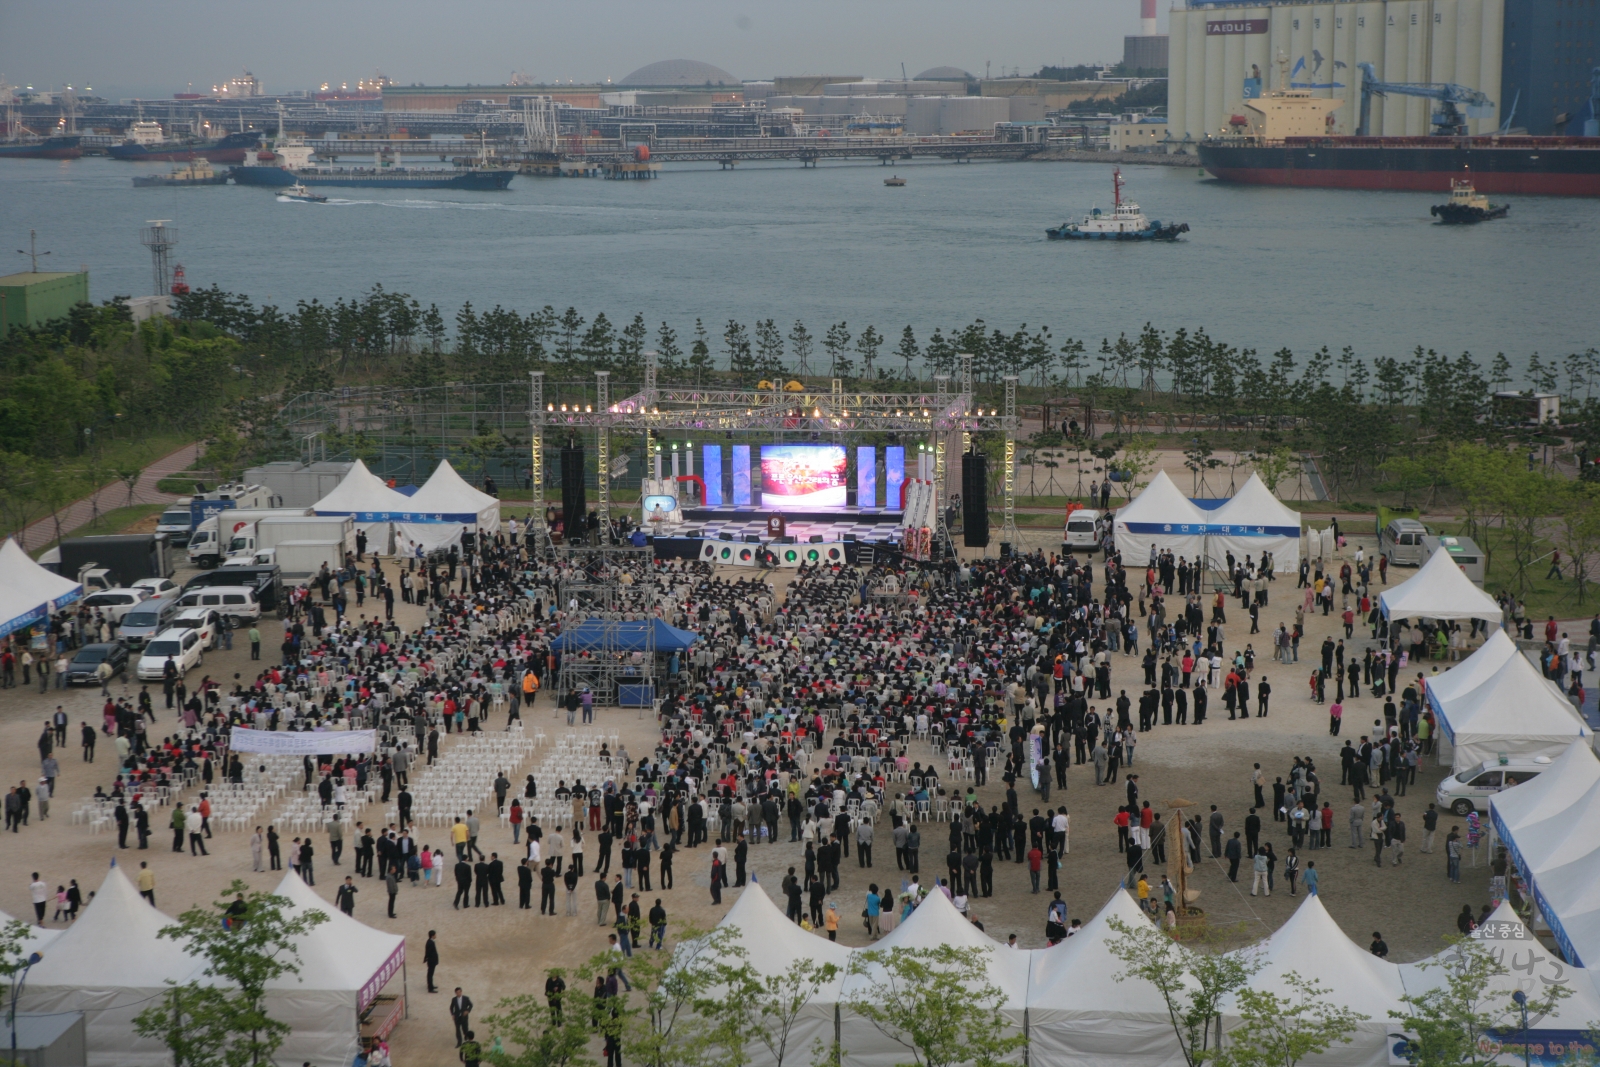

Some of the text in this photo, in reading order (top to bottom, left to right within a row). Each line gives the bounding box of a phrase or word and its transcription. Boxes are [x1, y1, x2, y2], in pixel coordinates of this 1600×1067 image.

[202, 505, 221, 515] ubc
[1163, 523, 1265, 534] 출연자 대기실
[1548, 1041, 1565, 1055] to
